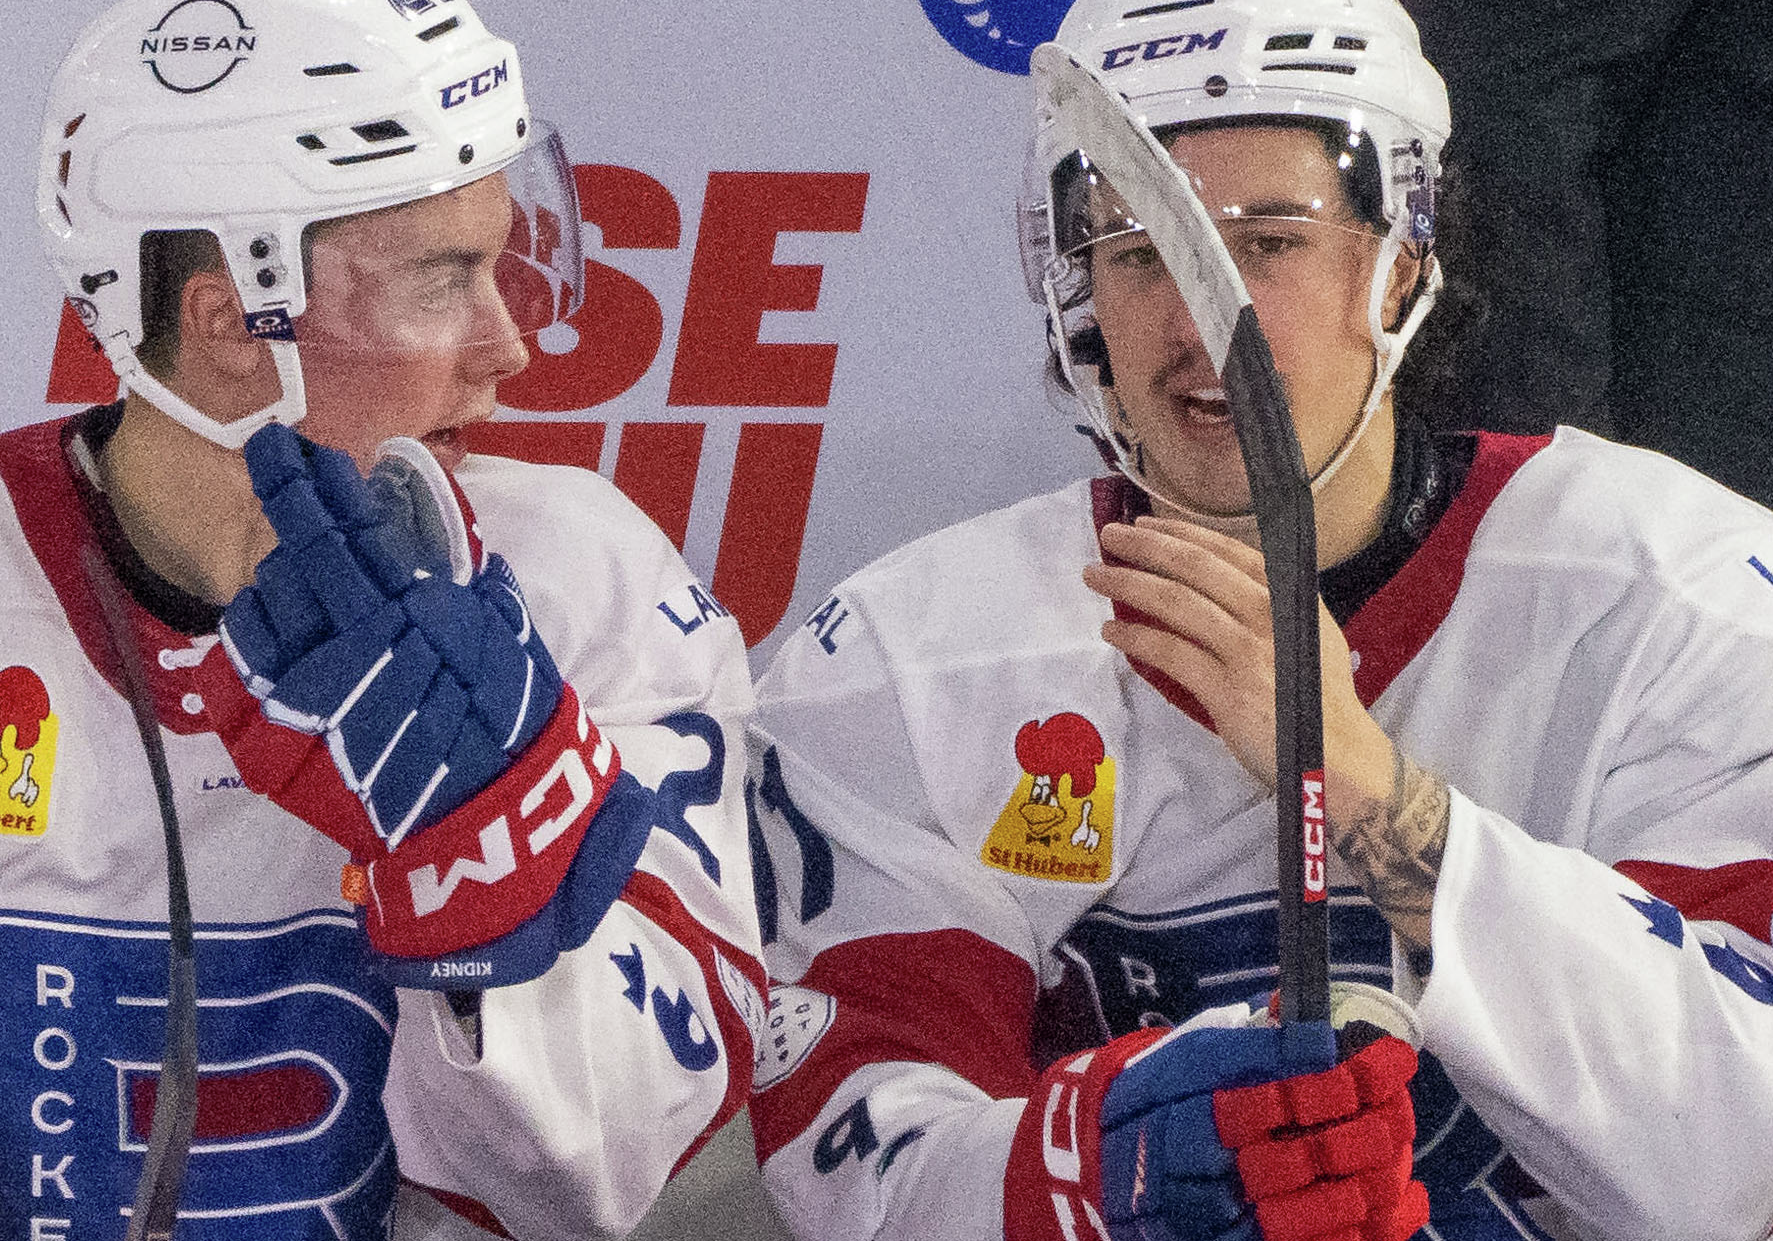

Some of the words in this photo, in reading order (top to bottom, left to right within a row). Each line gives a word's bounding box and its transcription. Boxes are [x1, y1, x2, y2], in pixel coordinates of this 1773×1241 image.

[139, 34, 256, 54] NISSAN
[1102, 28, 1229, 70] CCM
[440, 59, 508, 109] CCM
[1303, 780, 1325, 893] CCM
[432, 961, 492, 977] KIDNEY
